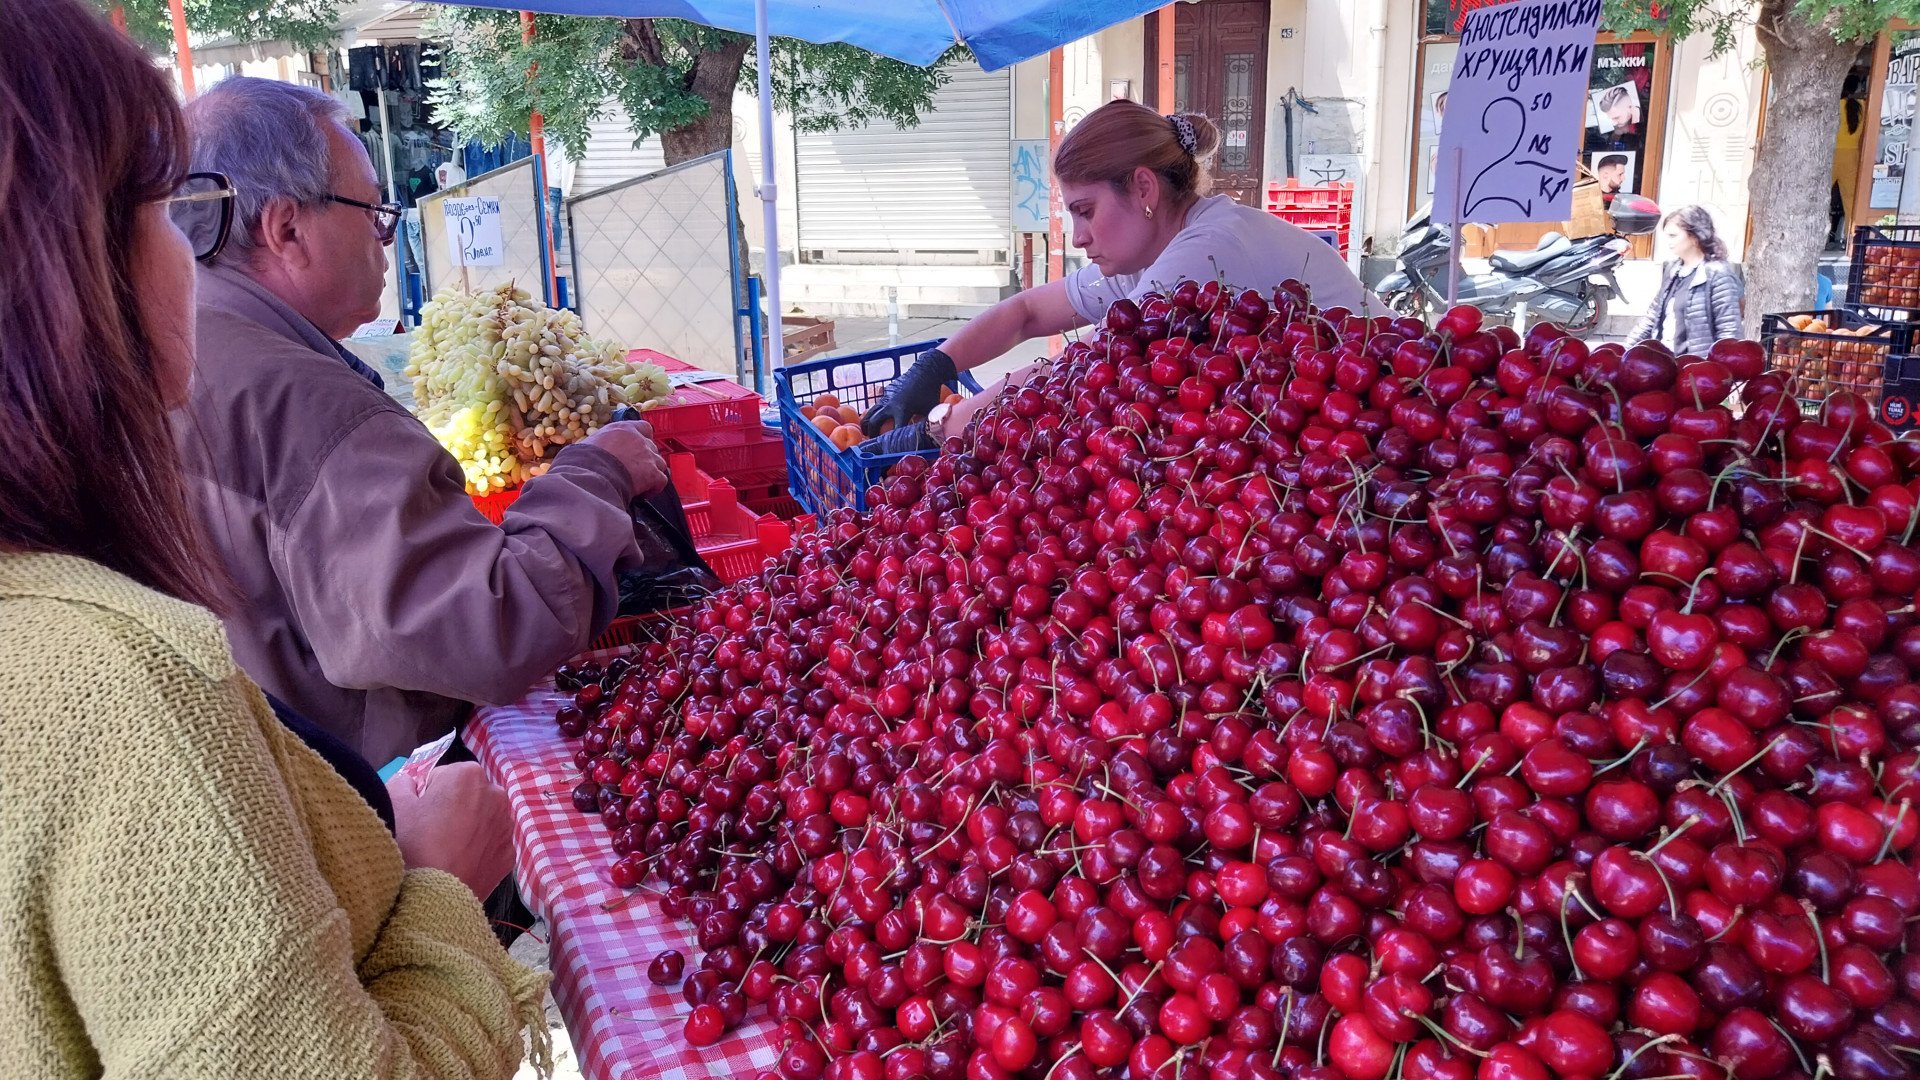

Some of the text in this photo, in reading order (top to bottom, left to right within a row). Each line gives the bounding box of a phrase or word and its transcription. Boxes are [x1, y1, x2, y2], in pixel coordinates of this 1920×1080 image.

[1281, 29, 1292, 38] 45
[1457, 43, 1588, 92] ХРУЩЯЛКИ
[1463, 92, 1552, 219] 2 50
